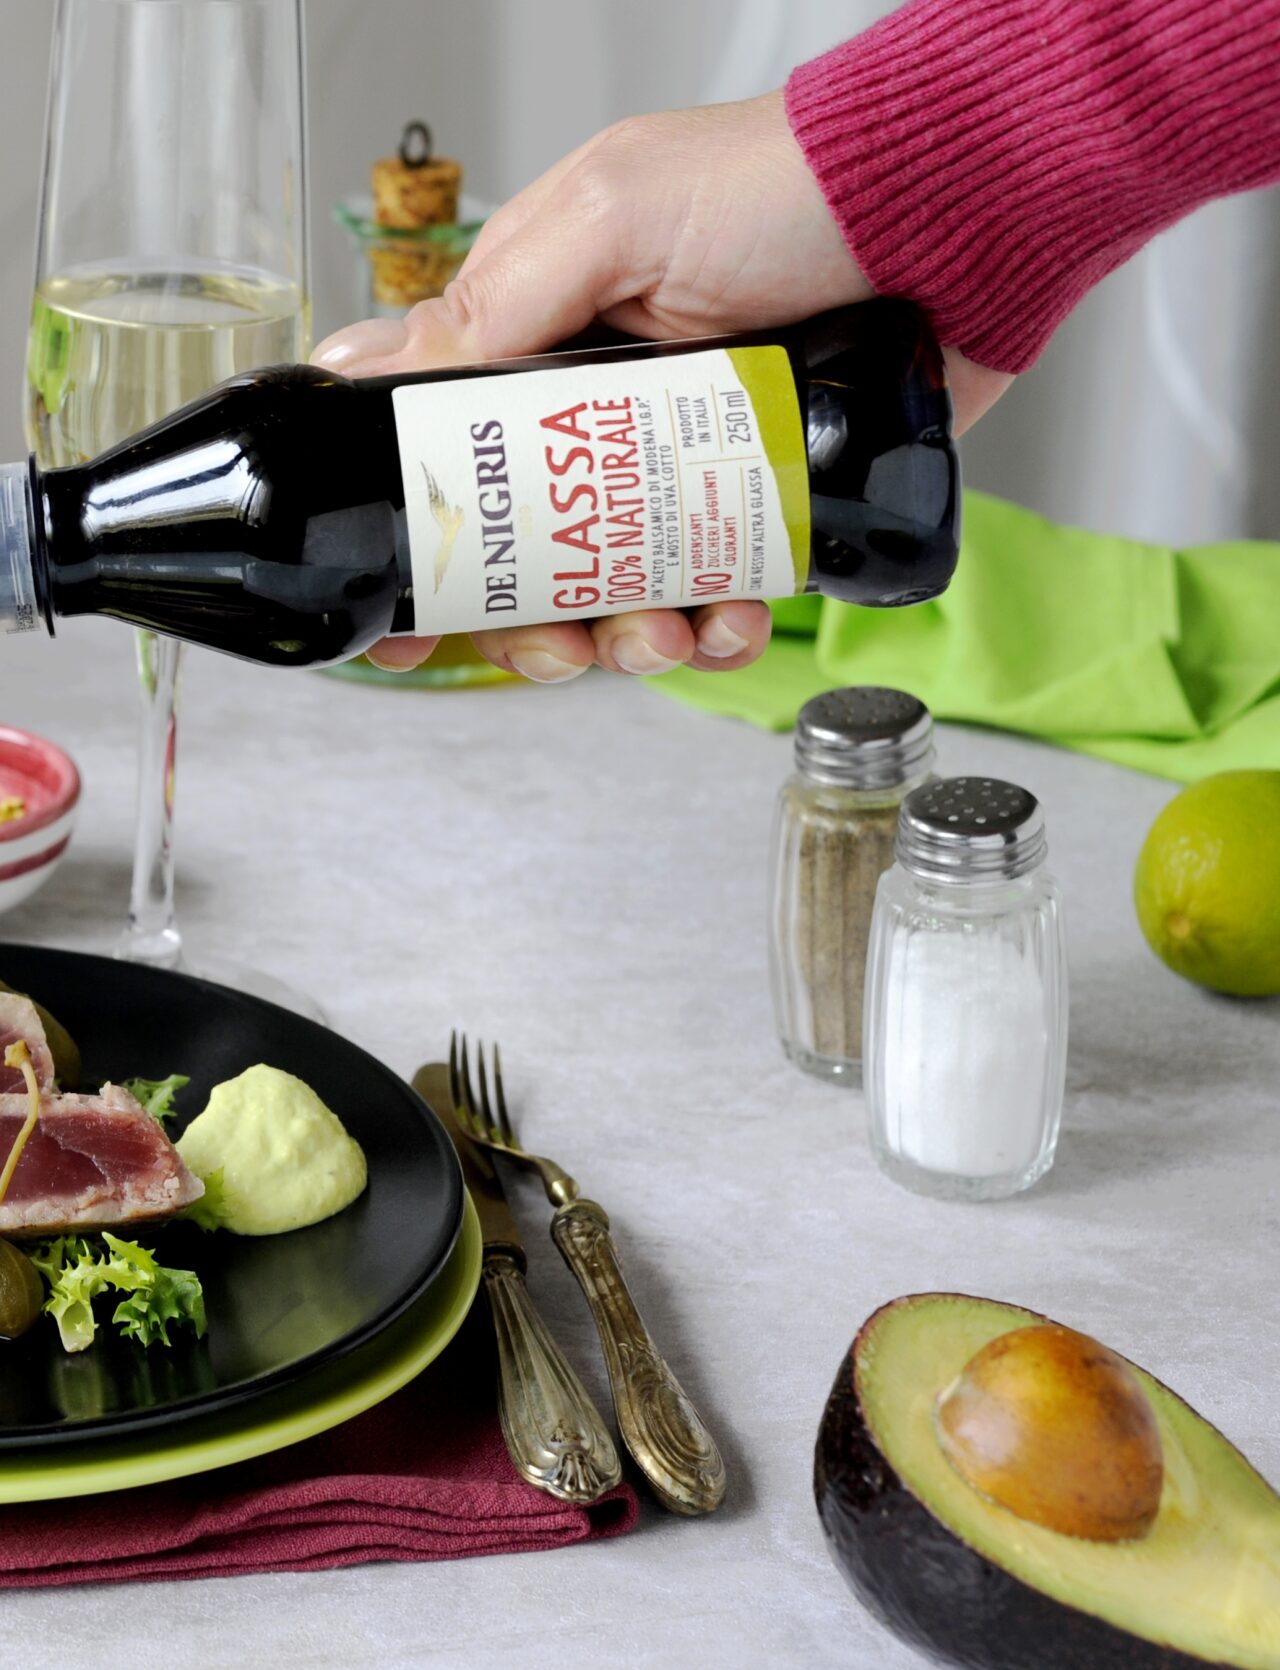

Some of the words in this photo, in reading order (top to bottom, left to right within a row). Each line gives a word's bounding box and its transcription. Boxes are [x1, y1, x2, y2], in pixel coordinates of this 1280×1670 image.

[693, 397, 710, 428] ITALIA
[719, 390, 746, 408] ml
[675, 396, 695, 448] PRODOTTO
[698, 432, 712, 443] IN
[725, 411, 751, 444] 250
[592, 396, 645, 549] NATURALE
[642, 429, 661, 476] MODENA
[659, 445, 675, 481] COTTO
[470, 419, 517, 569] NIGRIS
[539, 402, 601, 609] GLASSA
[647, 481, 661, 492] DI
[663, 484, 677, 507] UVA
[702, 470, 719, 521] AGGIUNTI
[748, 467, 764, 508] GLASSA
[650, 497, 665, 557] BALSAMICO
[665, 511, 678, 523] DI
[666, 526, 680, 558] MOSTO
[689, 513, 704, 570] ADDENSANTI
[707, 526, 720, 568] ZUCCHERI
[723, 516, 737, 567] COLORANTI
[485, 572, 517, 614] DE
[605, 555, 647, 605] 100%
[690, 573, 733, 597] NO
